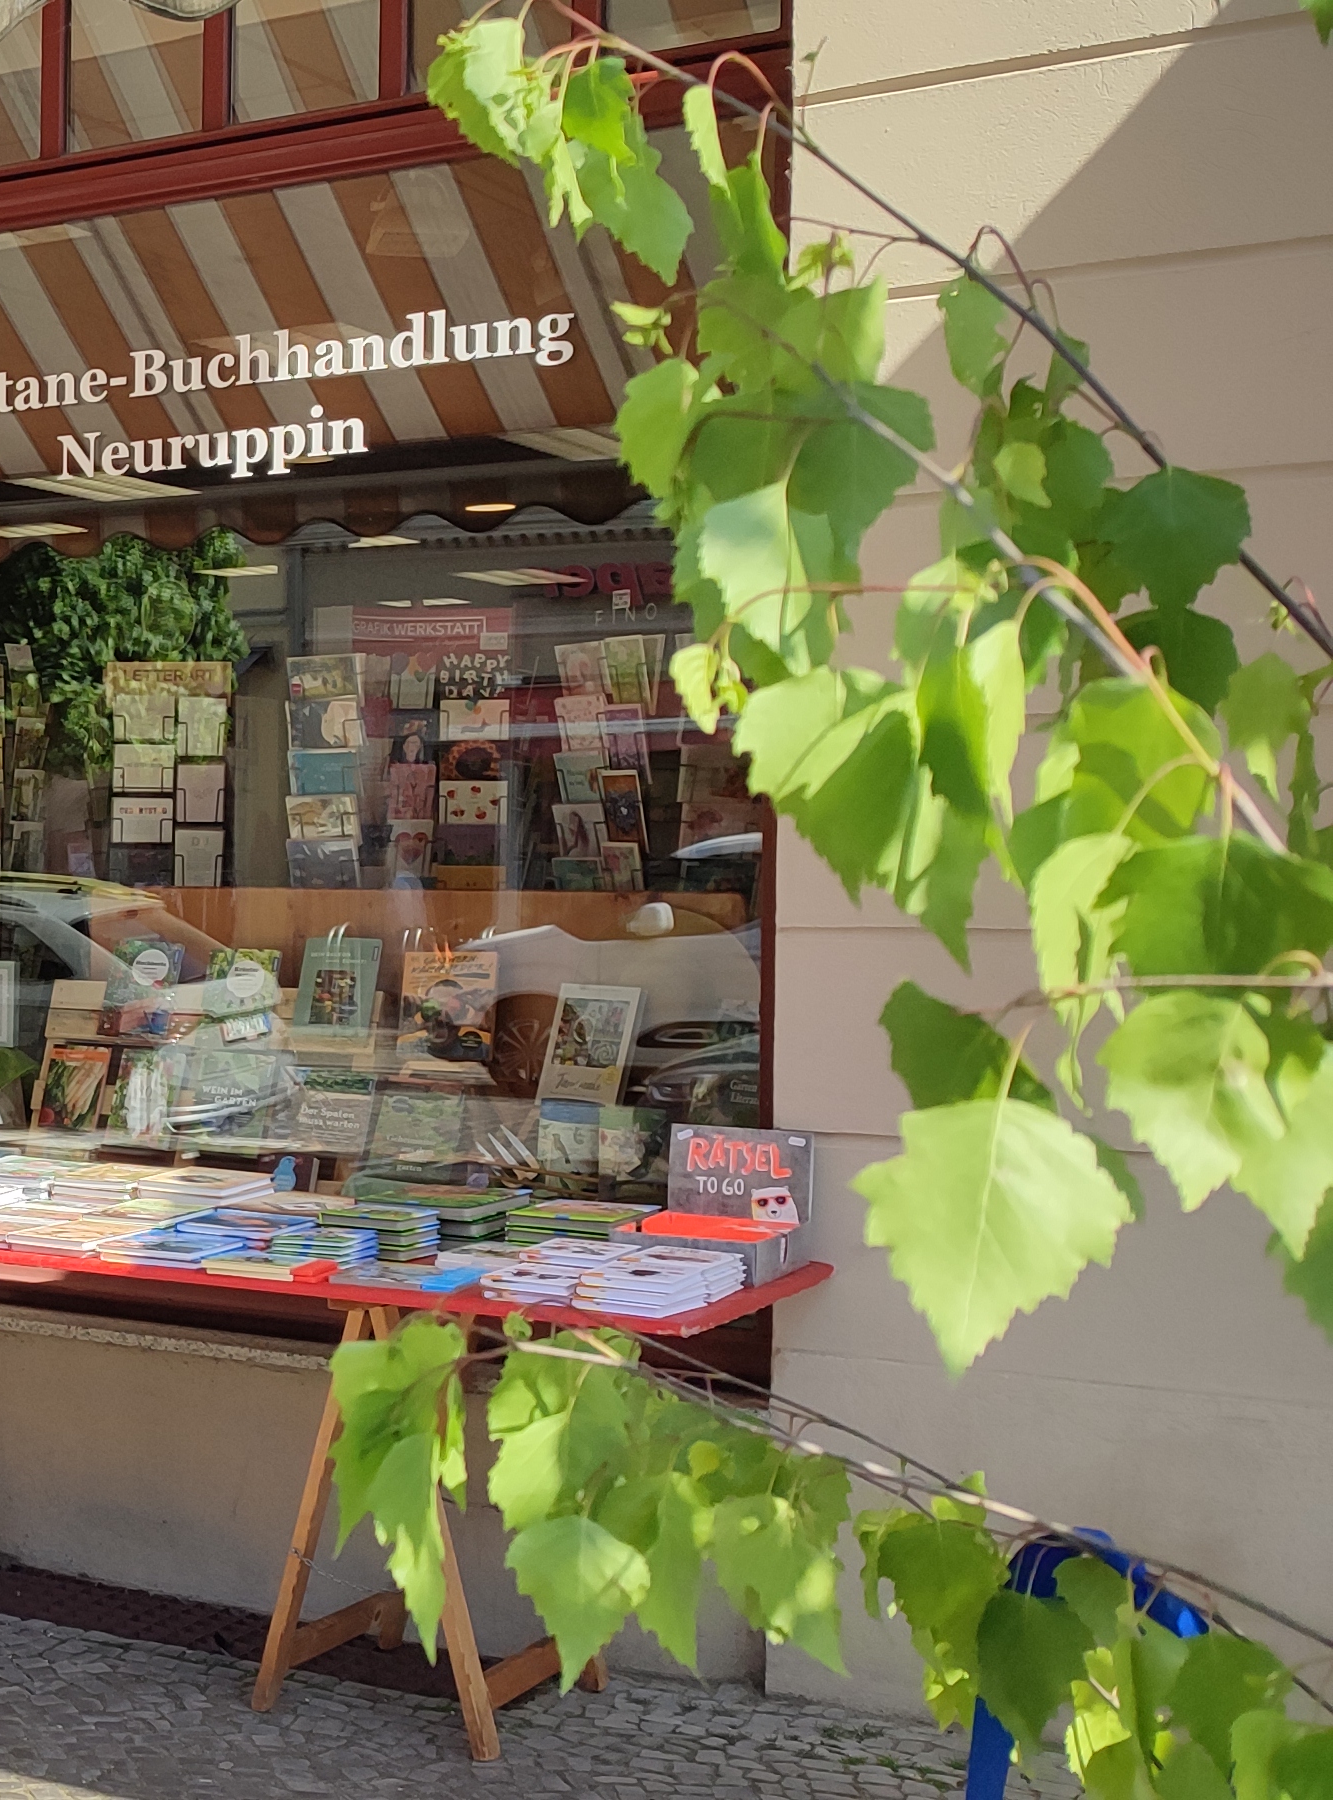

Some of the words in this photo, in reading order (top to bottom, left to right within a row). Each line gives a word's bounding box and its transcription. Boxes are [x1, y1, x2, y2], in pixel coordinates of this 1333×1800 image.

[56, 405, 369, 480] Neuruppin
[393, 622, 481, 635] WERKSTATT
[442, 653, 511, 672] HAPPY
[202, 1085, 229, 1095] WEIN
[231, 1087, 243, 1096] IM
[214, 1096, 257, 1107] GARTEN
[300, 1105, 319, 1115] Der
[321, 1108, 355, 1119] Spaten
[326, 1119, 360, 1129] warten
[686, 1133, 793, 1180] RÄTSEL
[695, 1175, 718, 1194] TO
[722, 1178, 745, 1196] GO
